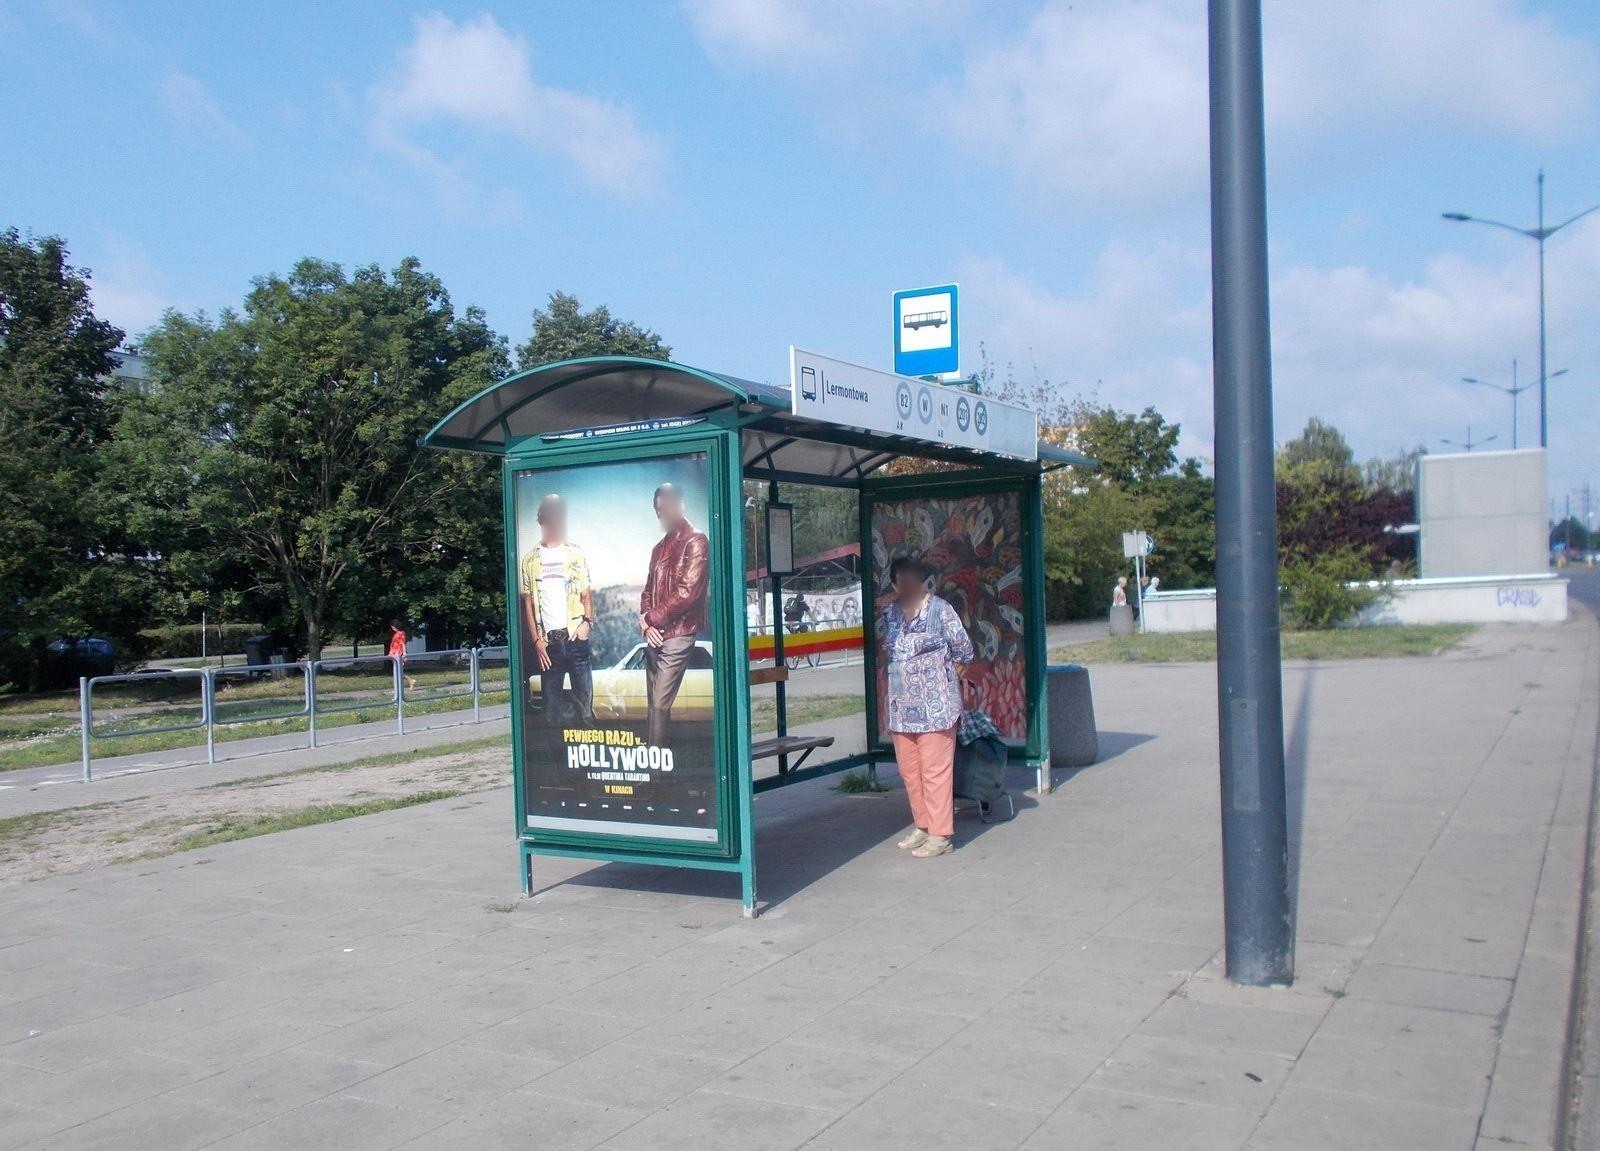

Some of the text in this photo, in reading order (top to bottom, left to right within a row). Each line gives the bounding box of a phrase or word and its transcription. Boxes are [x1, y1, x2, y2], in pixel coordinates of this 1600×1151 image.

[826, 380, 868, 402] Lermontowa
[900, 393, 909, 408] 82
[940, 403, 949, 416] N1
[563, 729, 604, 743] PEWNEGO
[605, 730, 633, 746] RAZU
[567, 744, 673, 771] HOLLYWOOD
[601, 771, 624, 781] QUENTINA
[624, 772, 650, 782] TARANTINO
[604, 785, 633, 795] W KINACH
